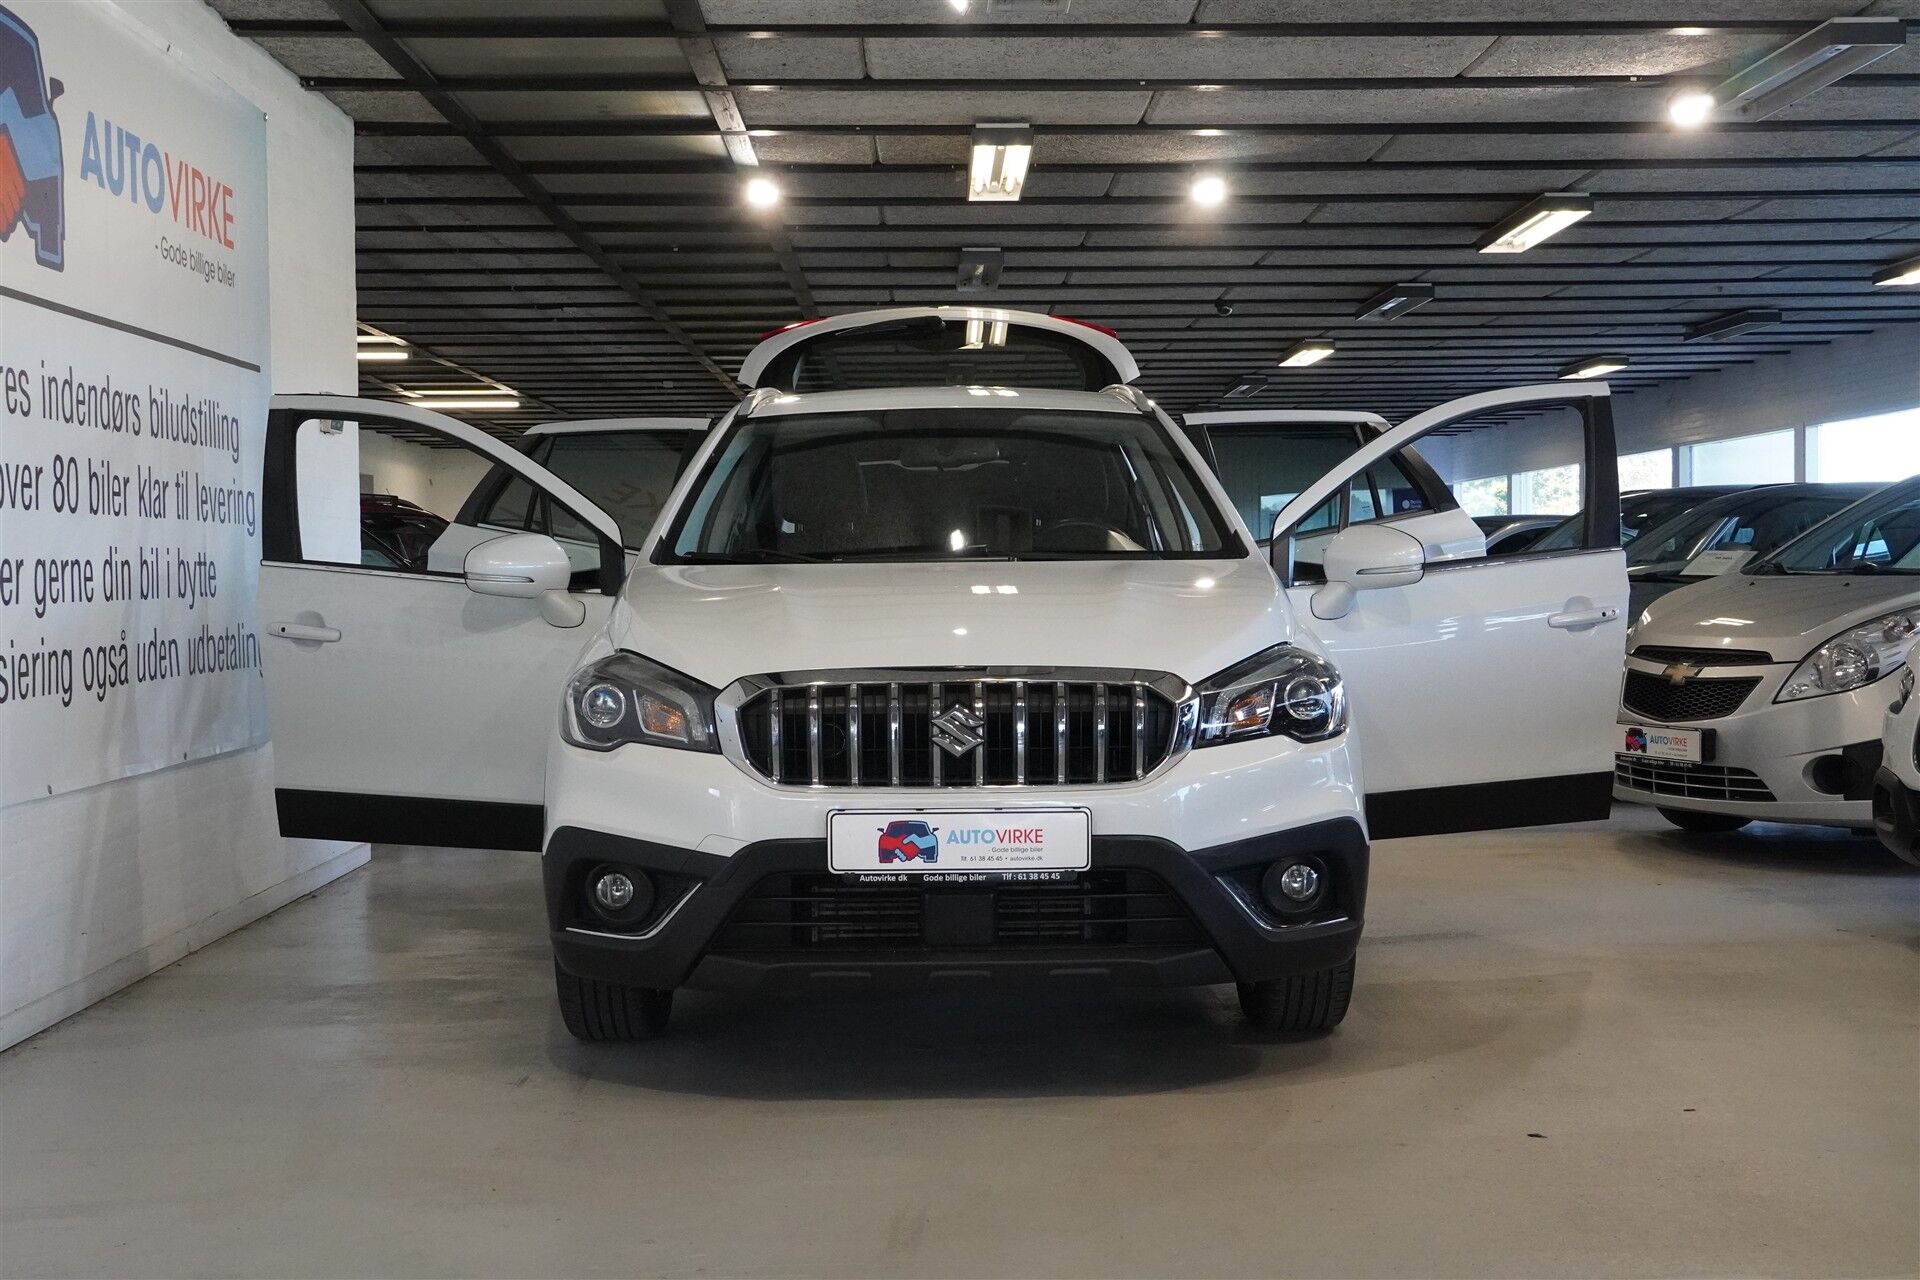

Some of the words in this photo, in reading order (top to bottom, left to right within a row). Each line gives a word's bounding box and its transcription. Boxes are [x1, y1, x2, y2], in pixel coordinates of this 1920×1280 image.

[80, 111, 234, 250] AUTOVIRKE
[161, 236, 187, 268] Gode
[41, 360, 141, 436] indendørs
[149, 384, 239, 463] biludstilling
[53, 454, 79, 514] 80
[88, 458, 130, 517] biler
[138, 465, 169, 520] klar
[175, 471, 189, 520] til
[196, 472, 255, 537] levering
[34, 557, 94, 618] gerne
[103, 546, 131, 602] din
[140, 547, 159, 600] bil
[166, 548, 170, 599] i
[177, 548, 217, 609] bytte
[83, 629, 129, 702] også
[137, 627, 180, 682] uden
[188, 622, 263, 678] udbetalin
[1649, 735, 1687, 747] AUTOVIRKE
[946, 829, 1043, 844] AUTOVIRKE
[945, 874, 968, 883] billige
[1050, 872, 1060, 880] 45
